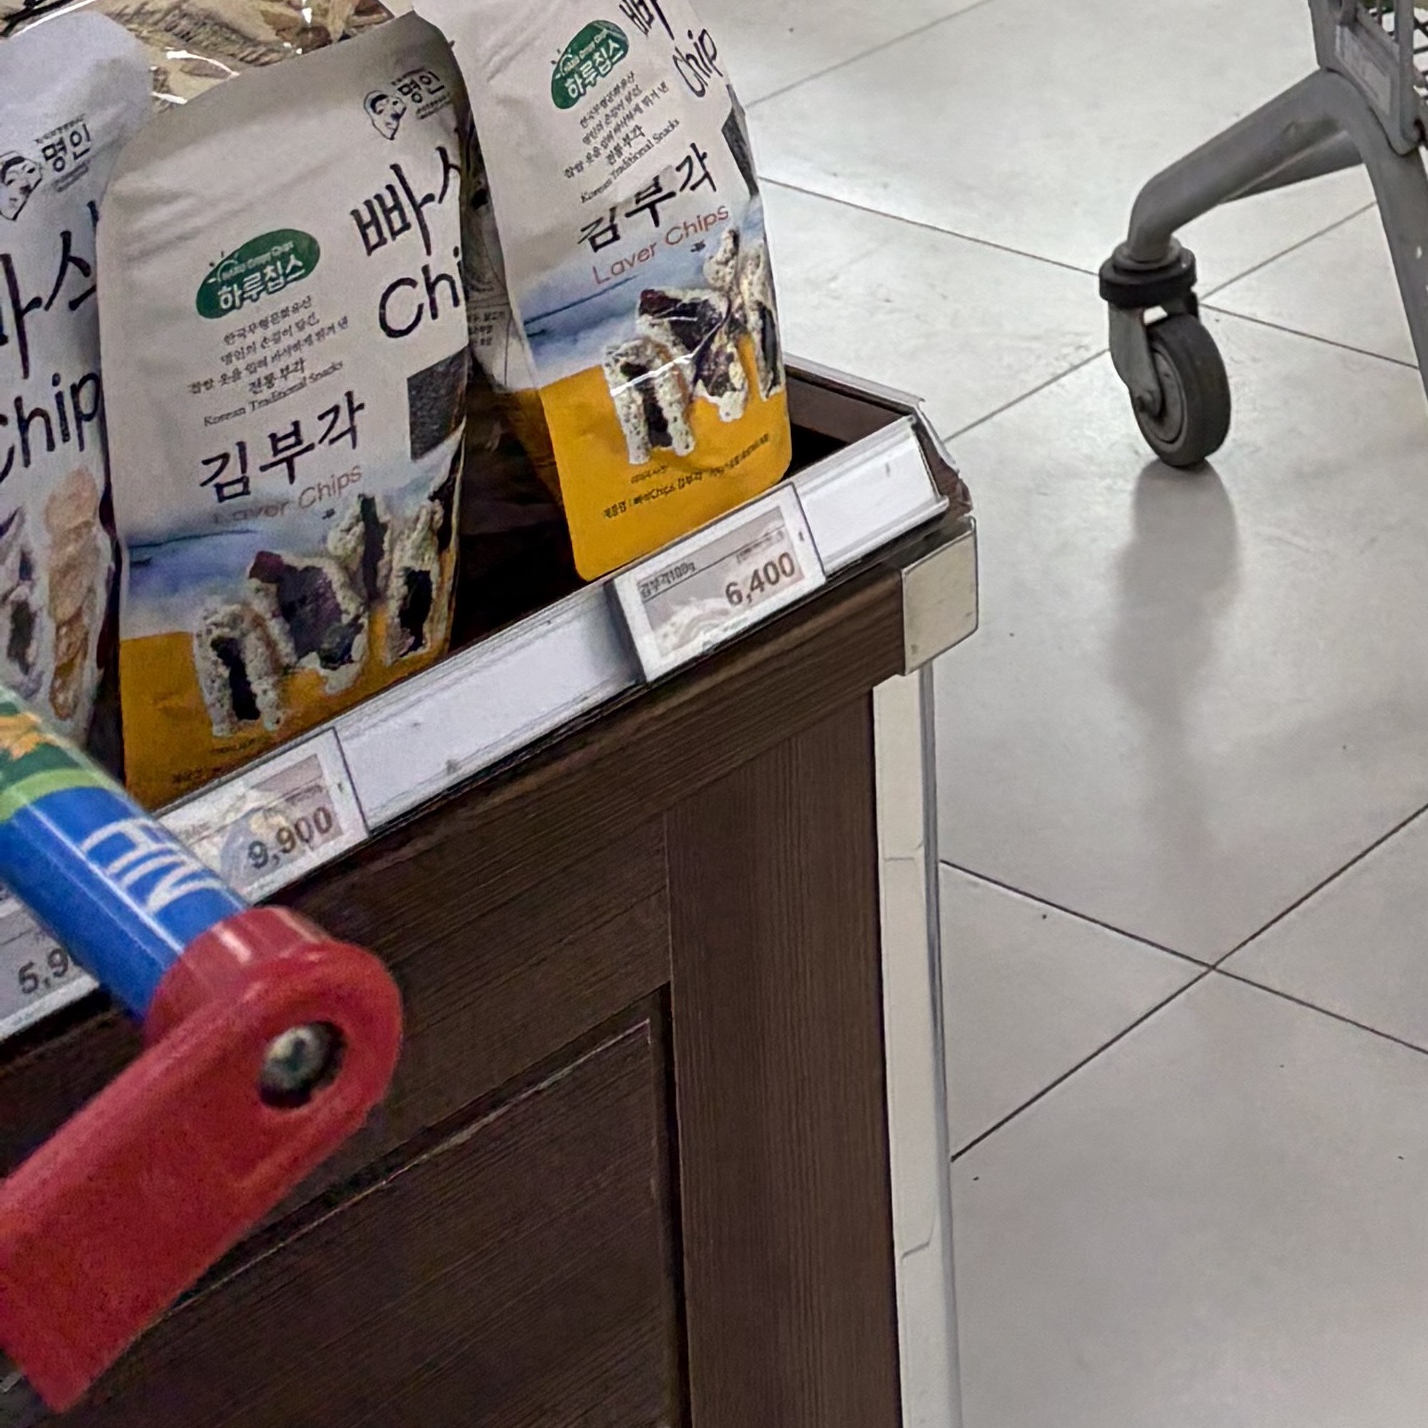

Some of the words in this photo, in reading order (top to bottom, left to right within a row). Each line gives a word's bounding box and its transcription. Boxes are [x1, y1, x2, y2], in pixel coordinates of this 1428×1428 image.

[396, 69, 447, 106] 명인
[564, 38, 625, 100] 하루칩스
[40, 123, 93, 174] 명인
[577, 142, 717, 254] 김부각
[591, 242, 659, 285] Laver
[664, 203, 730, 248] Chips
[217, 253, 306, 311] 하루칩스
[379, 245, 467, 340] Chi
[199, 389, 367, 505] 김부각
[298, 463, 364, 512] Chips
[724, 551, 797, 609] 6,400
[247, 803, 335, 871] 9,900
